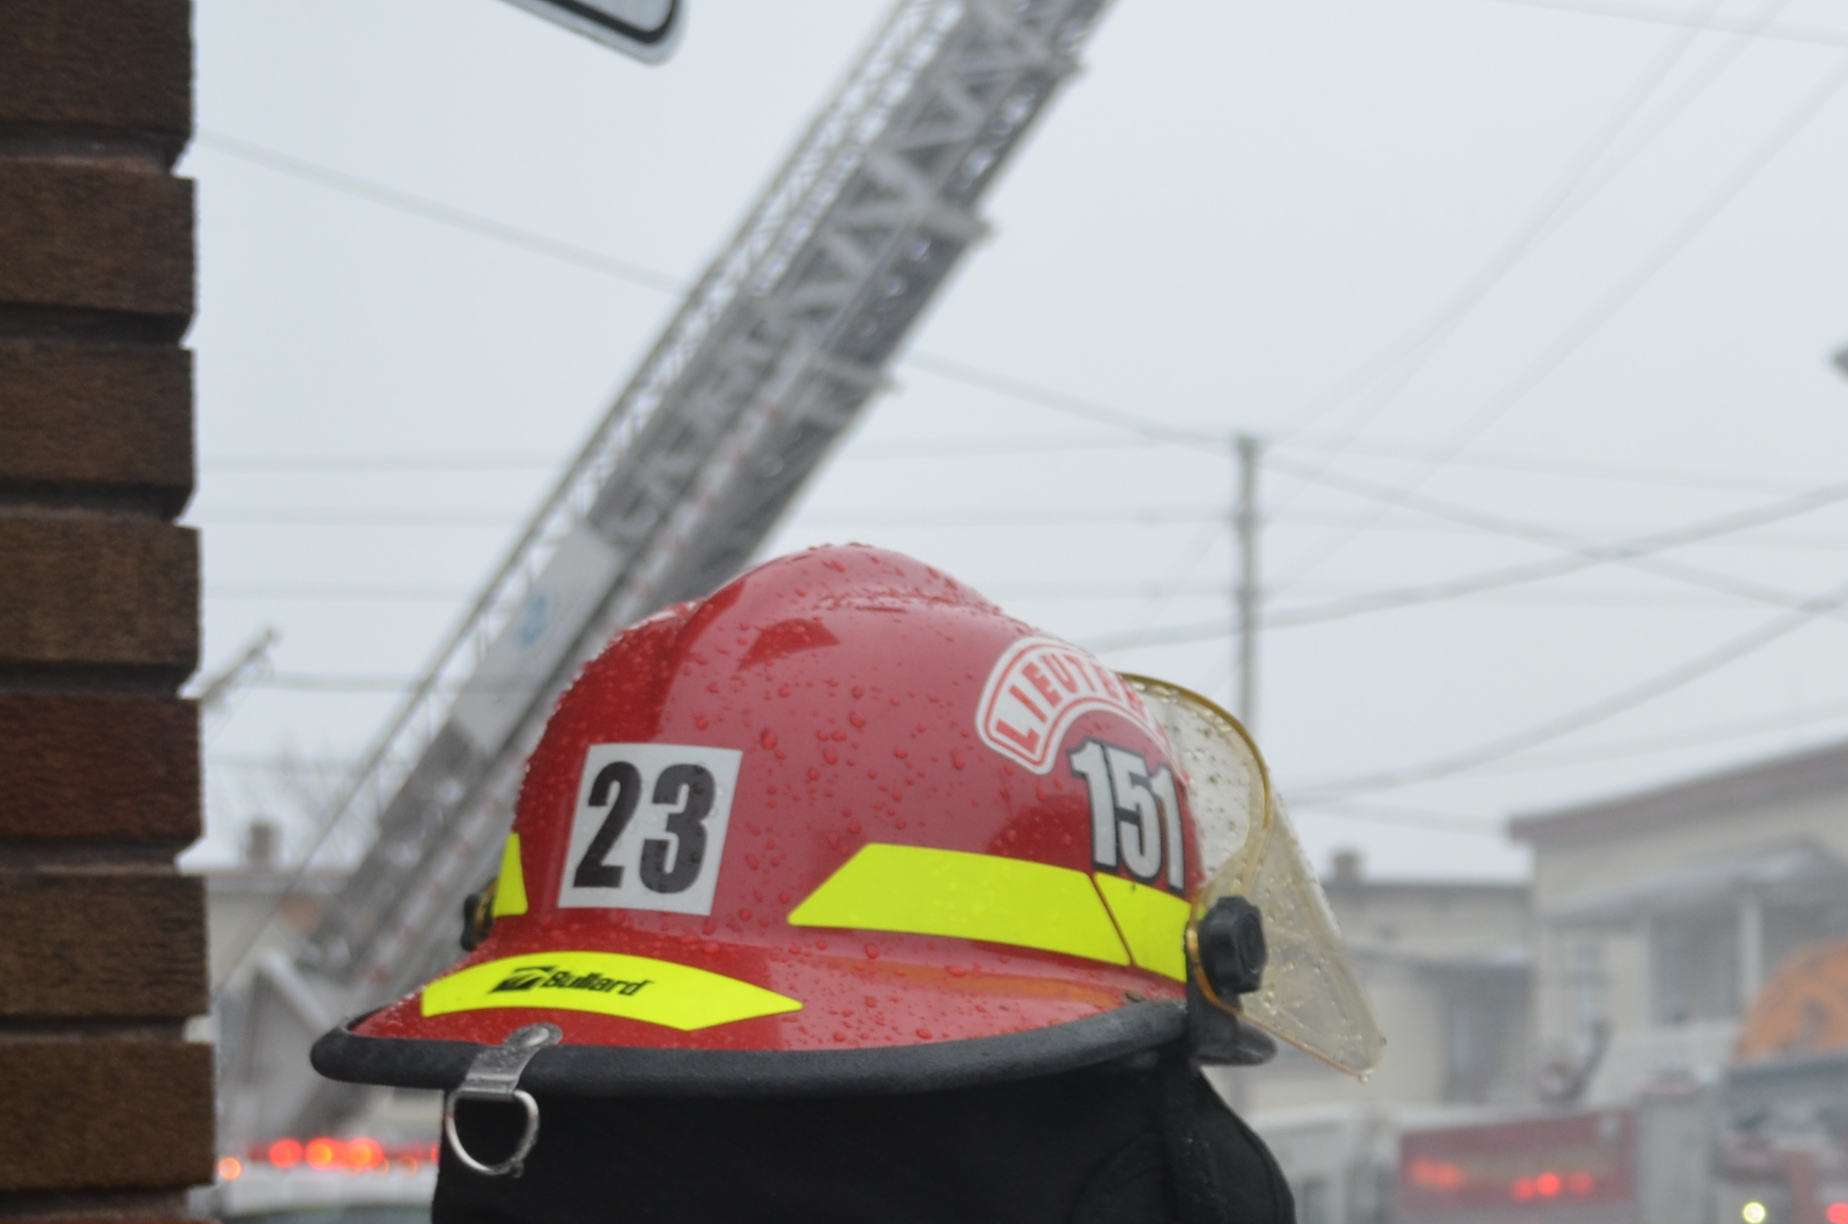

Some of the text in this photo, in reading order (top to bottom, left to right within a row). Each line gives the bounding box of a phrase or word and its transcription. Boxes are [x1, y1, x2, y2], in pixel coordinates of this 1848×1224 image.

[572, 761, 717, 895] 23
[1067, 736, 1185, 897] 151
[541, 970, 653, 996] Bullard
